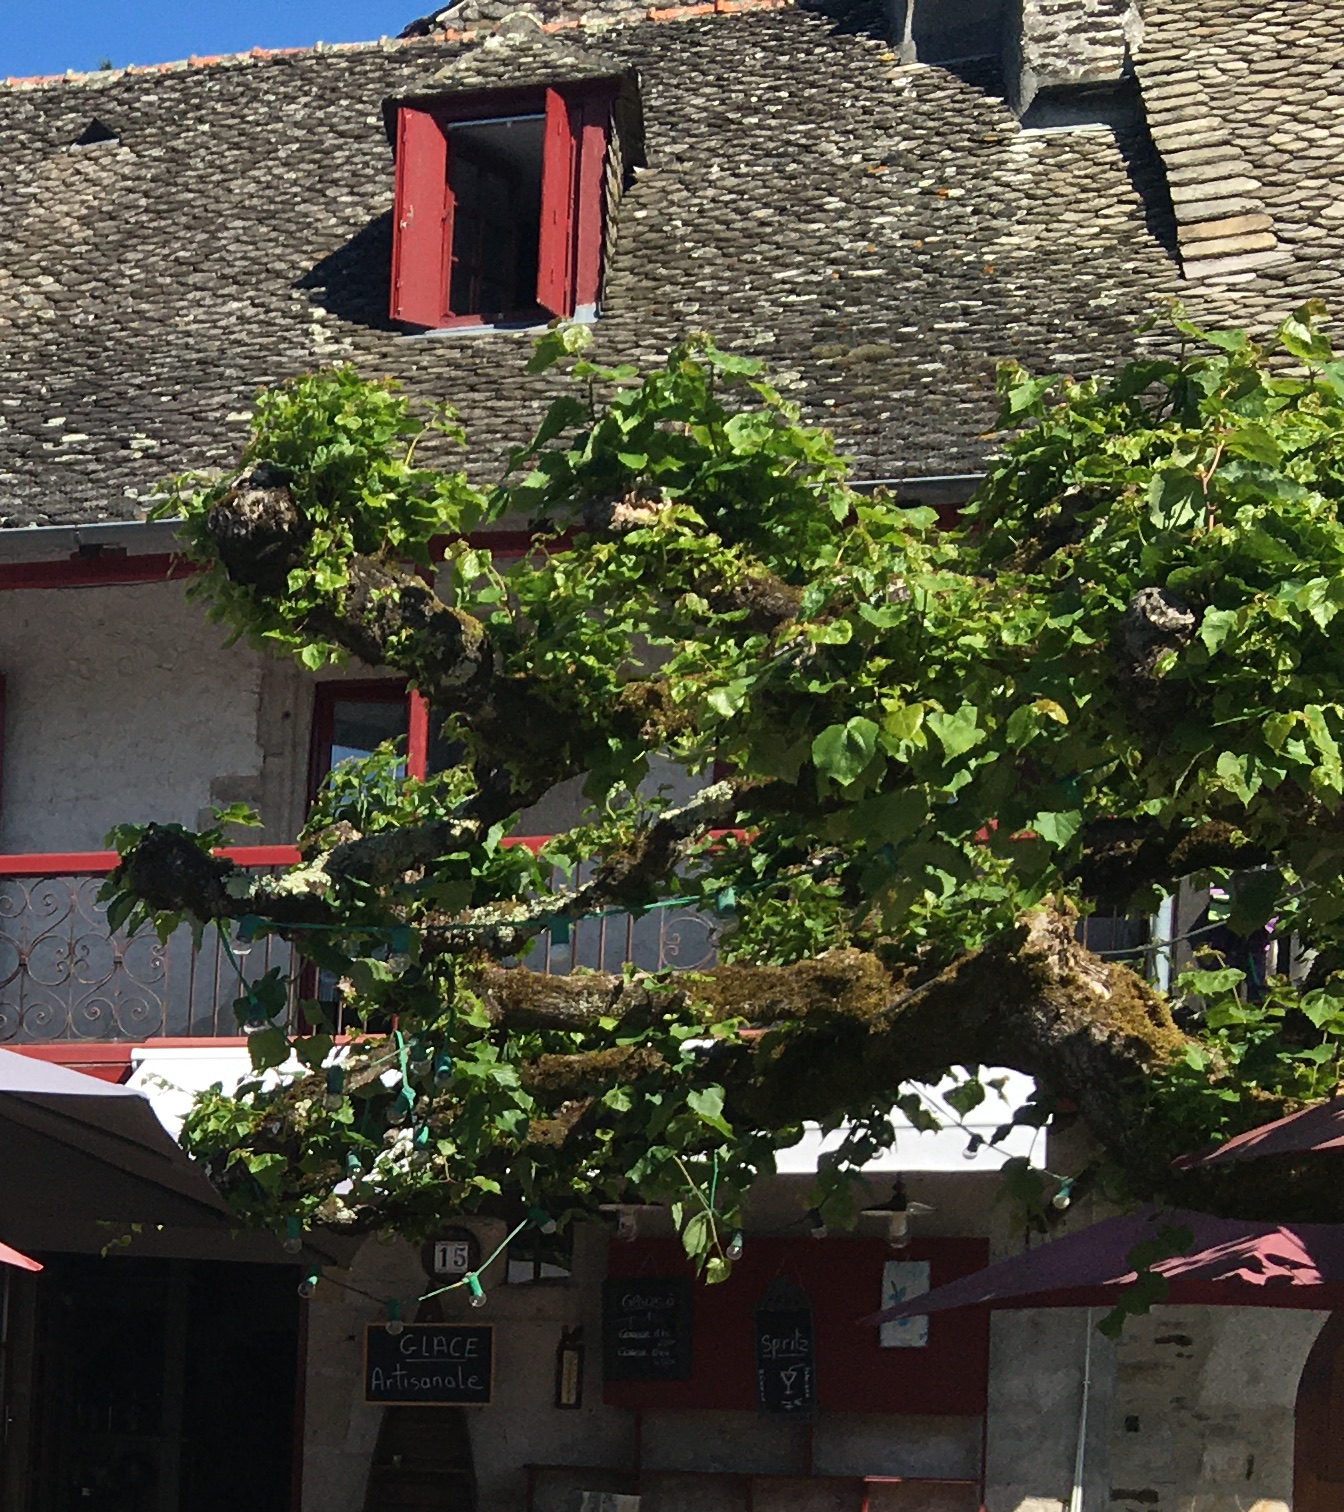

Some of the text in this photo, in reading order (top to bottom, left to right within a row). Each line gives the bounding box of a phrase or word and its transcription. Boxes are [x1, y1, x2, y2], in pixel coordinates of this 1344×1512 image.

[439, 1246, 467, 1268] 15
[399, 1333, 479, 1357] GLACE
[761, 1328, 808, 1360] Spritz
[371, 1363, 484, 1391] Artisanale
